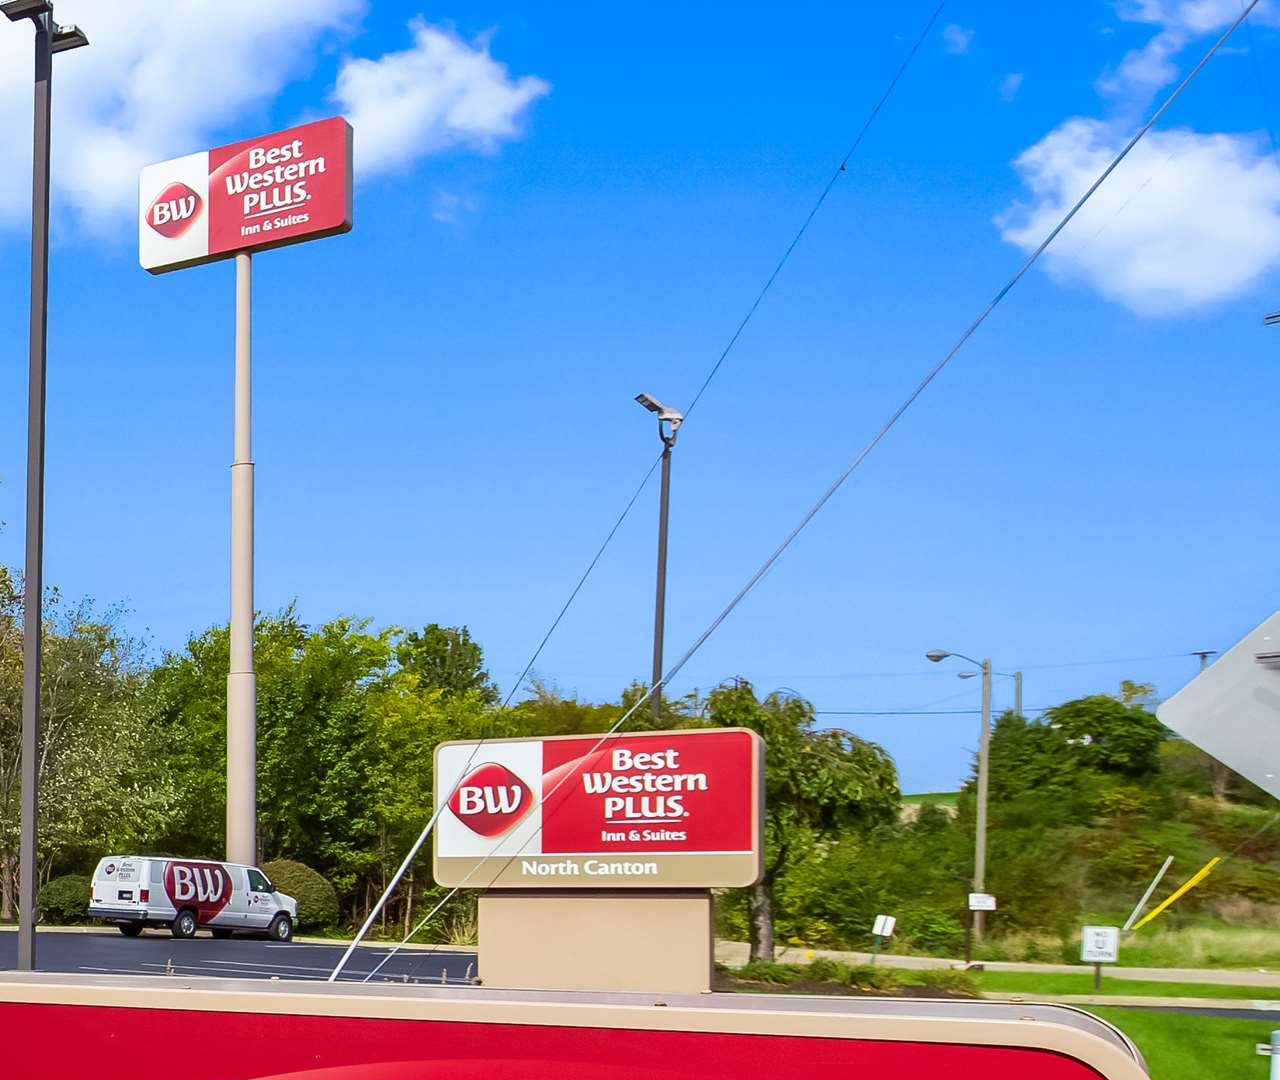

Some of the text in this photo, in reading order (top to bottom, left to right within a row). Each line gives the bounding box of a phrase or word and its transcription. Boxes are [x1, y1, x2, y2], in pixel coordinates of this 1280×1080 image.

[248, 139, 304, 170] Best
[225, 156, 326, 196] Western
[153, 195, 196, 226] BW
[241, 213, 310, 236] Inn & Suites
[612, 748, 680, 771] Best
[582, 771, 709, 795] Western
[459, 785, 522, 815] BW
[601, 829, 687, 842] Inn & Suites
[521, 860, 659, 876] North Canton
[173, 866, 223, 902] BW
